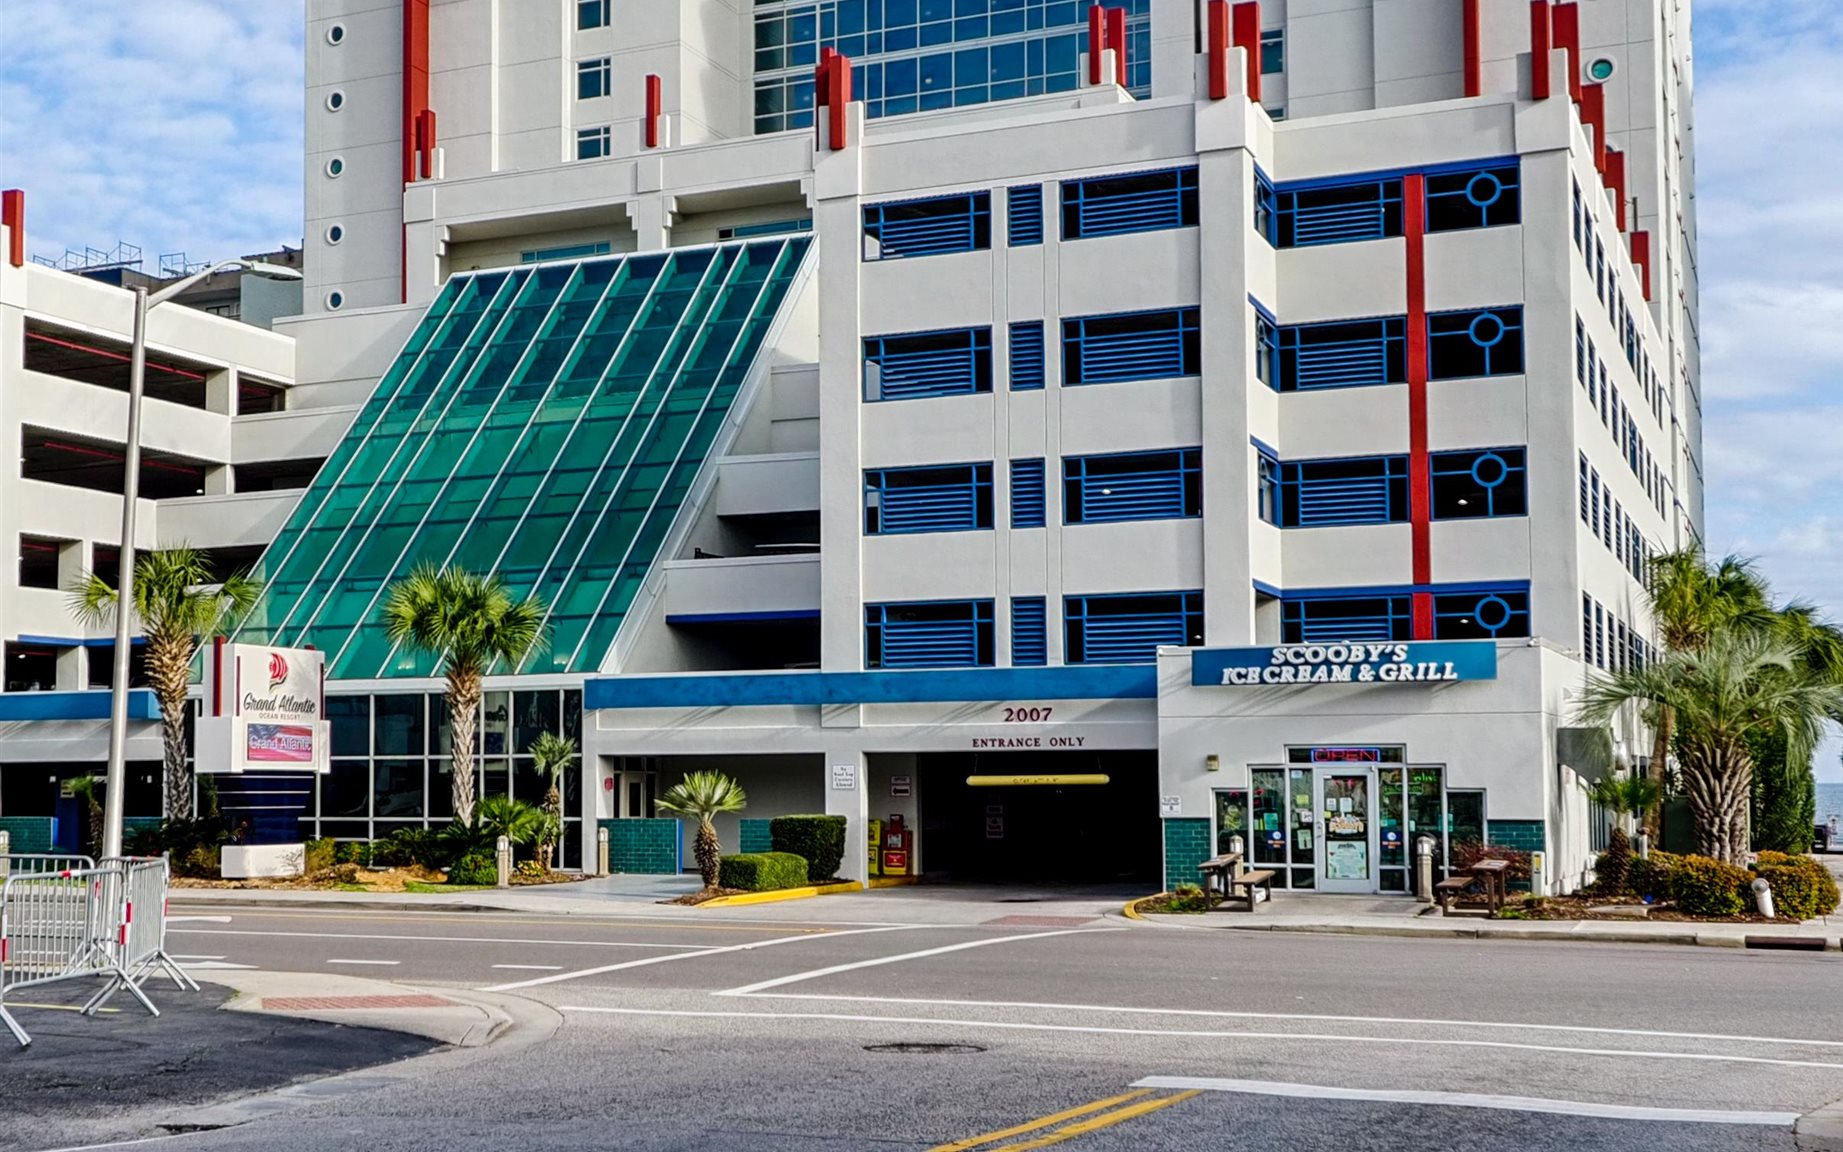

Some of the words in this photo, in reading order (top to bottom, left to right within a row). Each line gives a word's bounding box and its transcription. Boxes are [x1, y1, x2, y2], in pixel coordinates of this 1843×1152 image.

[1271, 645, 1408, 665] SCOOBY'S
[1221, 667, 1260, 685] ICE
[1263, 665, 1352, 684] CREAM
[1358, 664, 1376, 682] &
[1379, 663, 1458, 682] GRILL
[243, 692, 278, 711] Grand
[279, 694, 316, 714] Atlantic
[1003, 707, 1053, 722] 2007
[249, 735, 278, 750] Grand
[972, 738, 1041, 748] ENTRANCE
[1049, 737, 1085, 747] ONLY
[1314, 748, 1376, 762] OPEN
